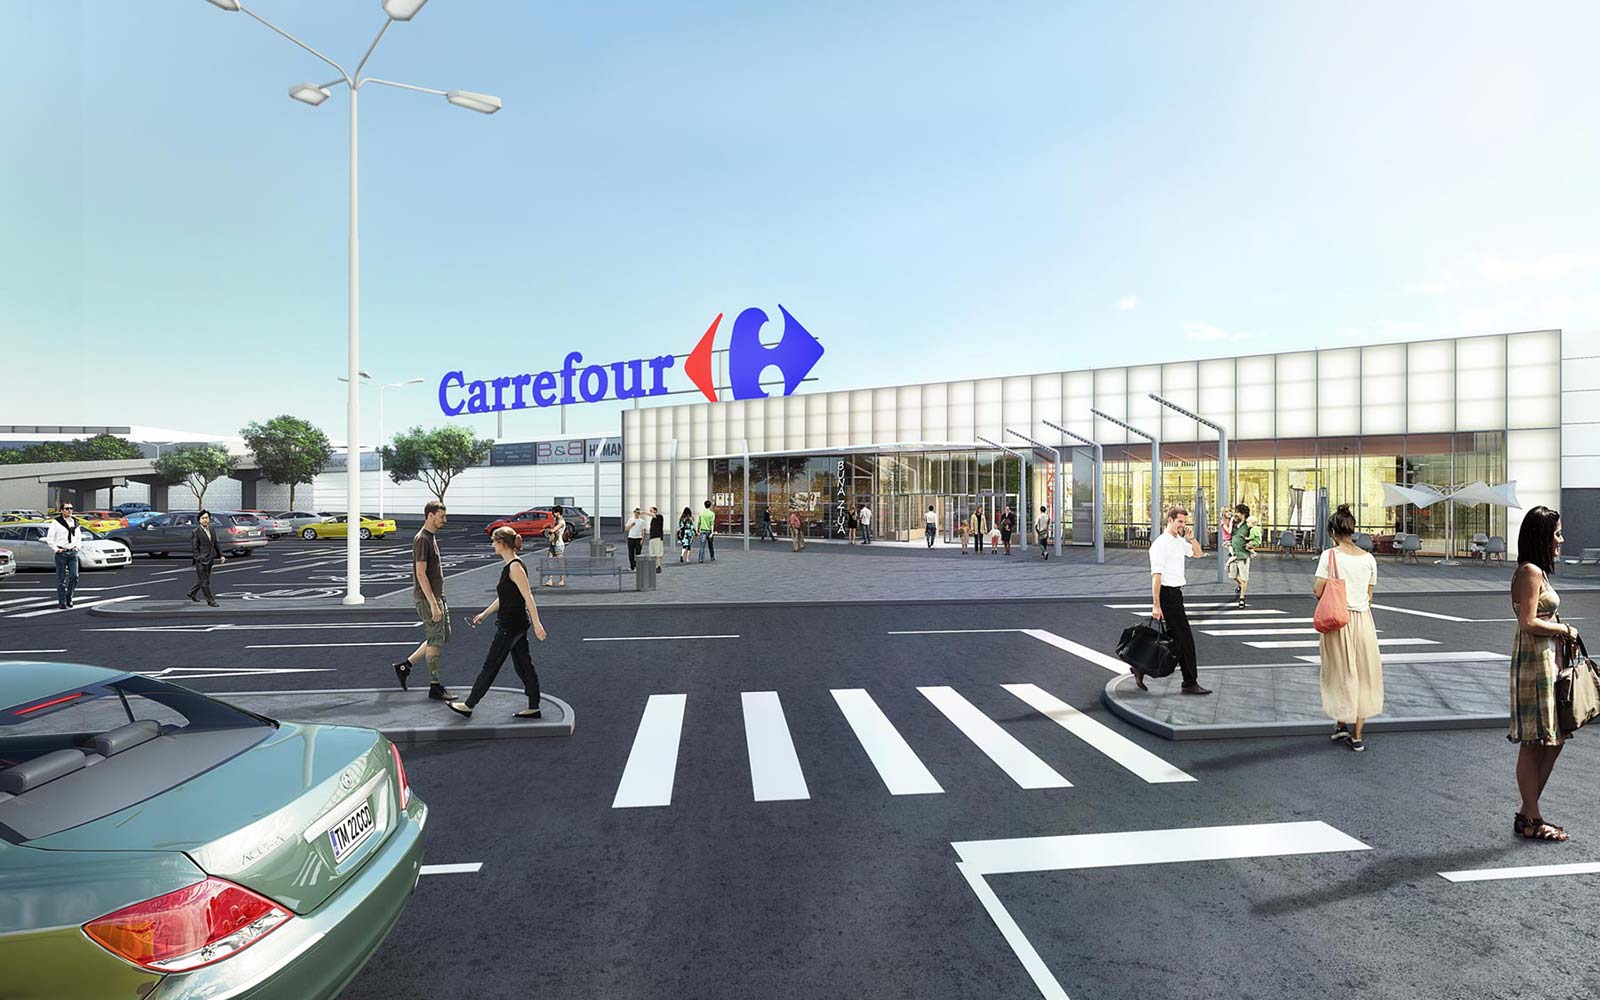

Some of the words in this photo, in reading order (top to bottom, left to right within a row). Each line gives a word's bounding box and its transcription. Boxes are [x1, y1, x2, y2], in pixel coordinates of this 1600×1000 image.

[438, 351, 675, 416] Carrefour
[589, 442, 622, 457] HMAN
[837, 460, 846, 496] BUNA
[334, 823, 351, 850] TM
